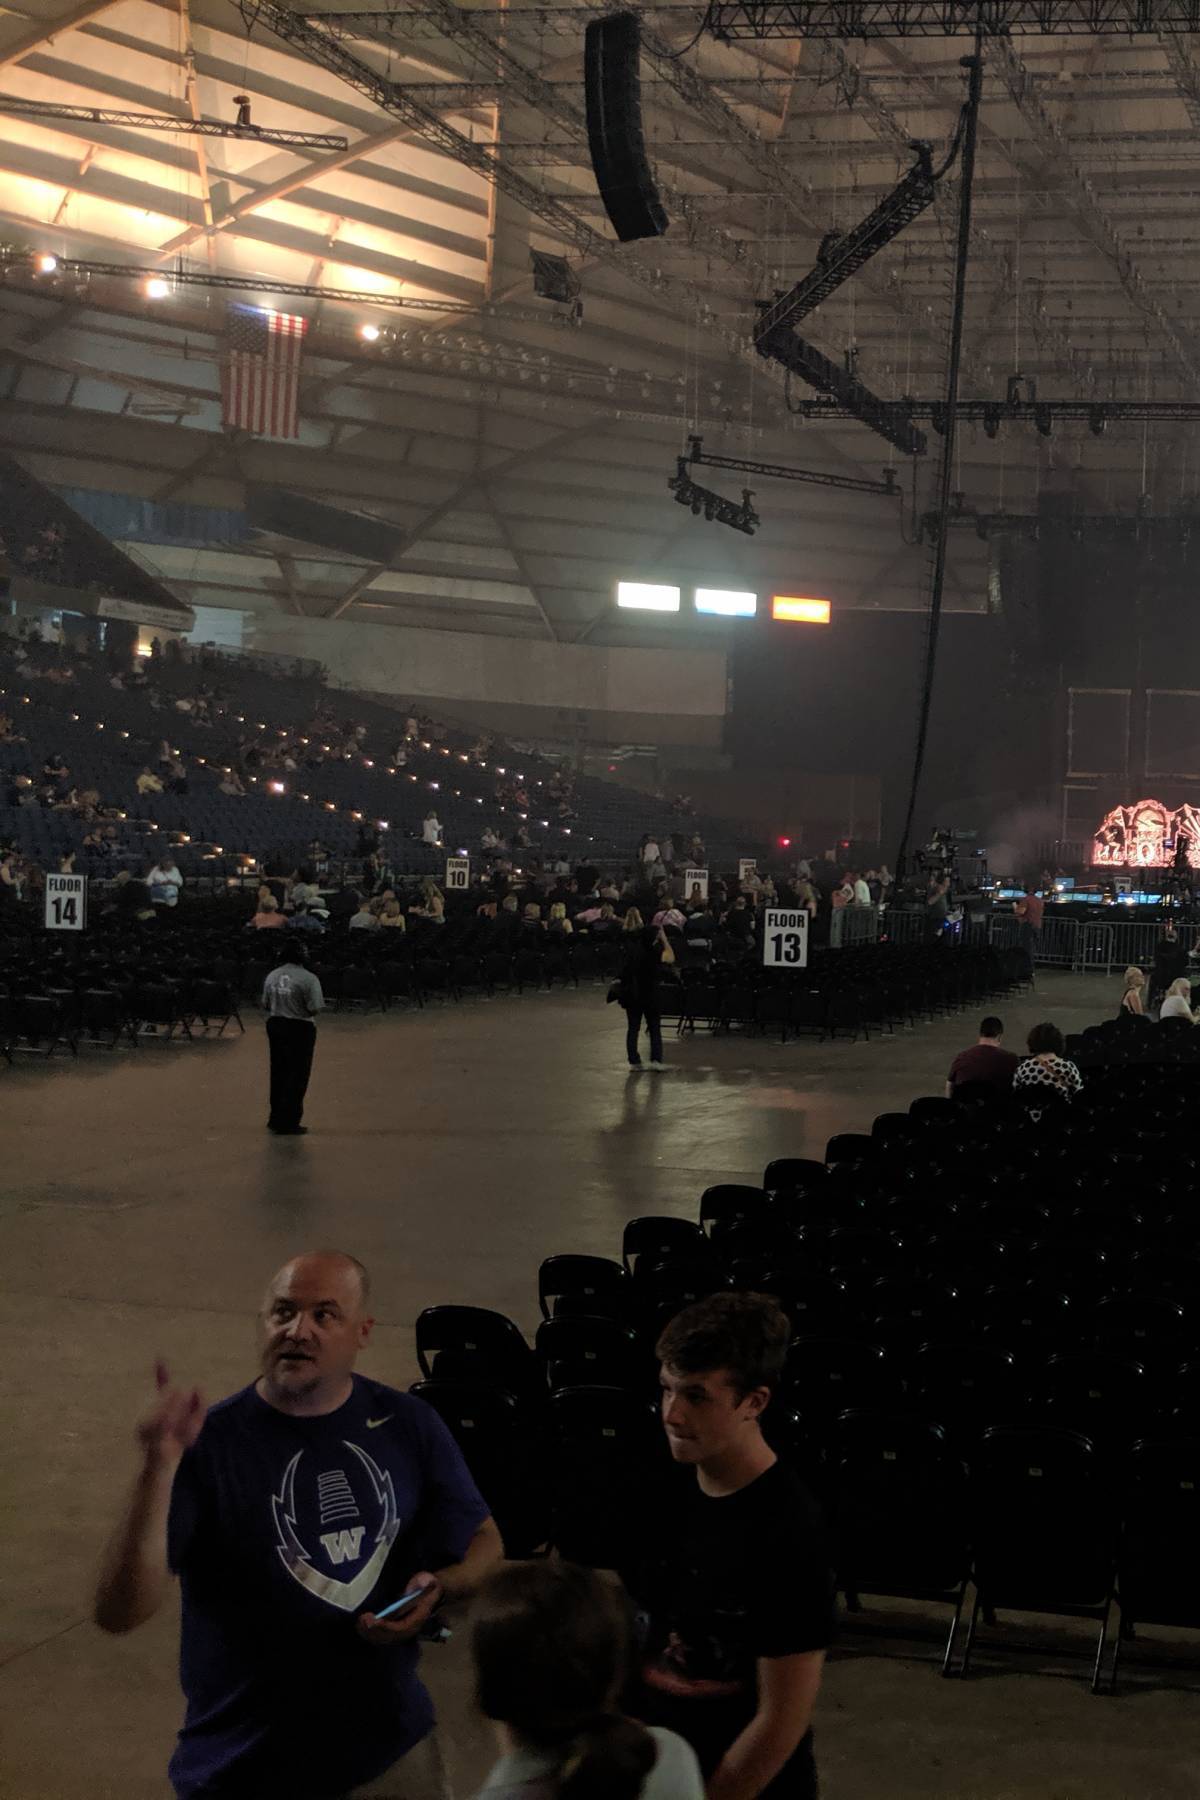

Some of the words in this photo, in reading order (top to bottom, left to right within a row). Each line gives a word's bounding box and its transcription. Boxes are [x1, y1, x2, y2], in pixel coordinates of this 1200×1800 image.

[449, 870, 466, 887] 10
[687, 871, 707, 880] FLOOR
[49, 877, 82, 892] FLOOR
[51, 897, 78, 925] 14
[768, 912, 805, 928] FLOOR
[770, 933, 801, 963] 13
[319, 1525, 367, 1565] W
